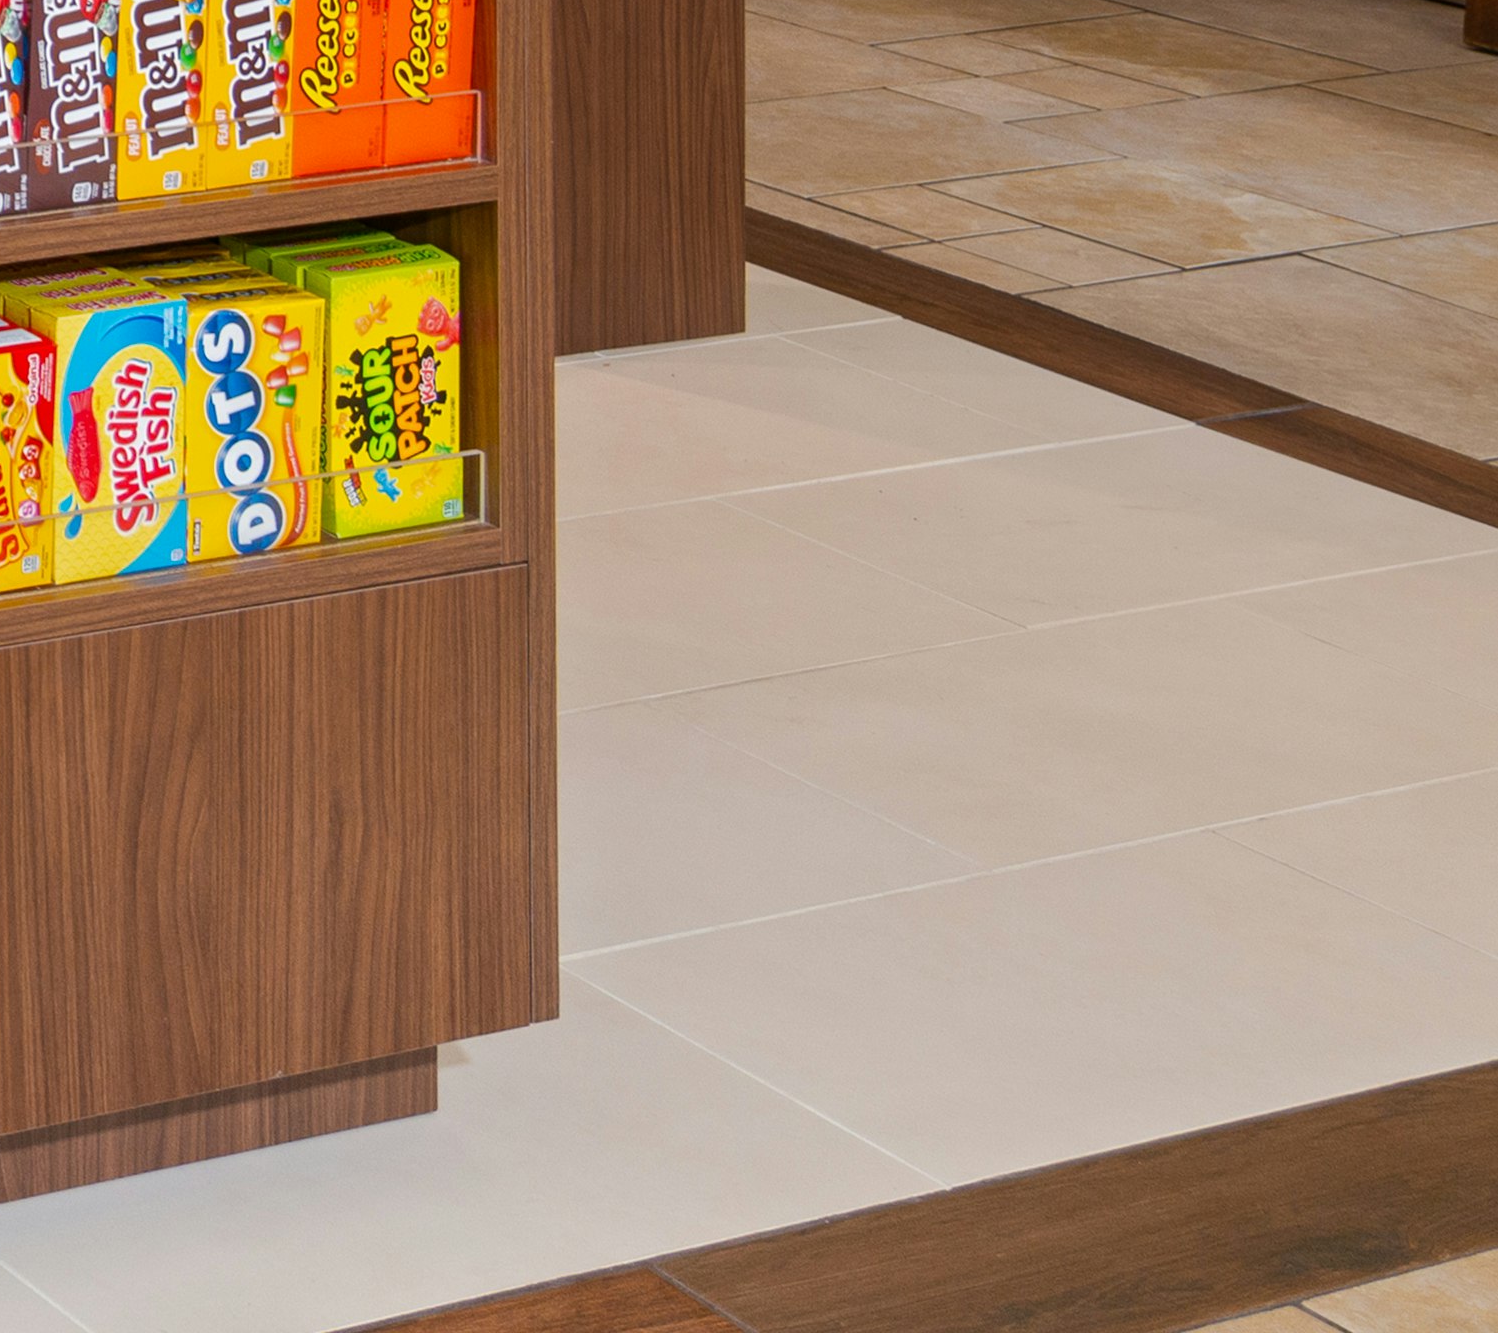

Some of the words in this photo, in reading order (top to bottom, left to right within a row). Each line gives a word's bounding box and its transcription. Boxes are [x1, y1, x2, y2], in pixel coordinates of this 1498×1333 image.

[27, 354, 39, 404] Original
[207, 319, 280, 549] DOTS
[362, 346, 396, 462] SOUR
[395, 334, 430, 461] PATCH
[419, 357, 437, 405] Kids
[109, 359, 155, 537] Swedish
[137, 387, 178, 489] Fish
